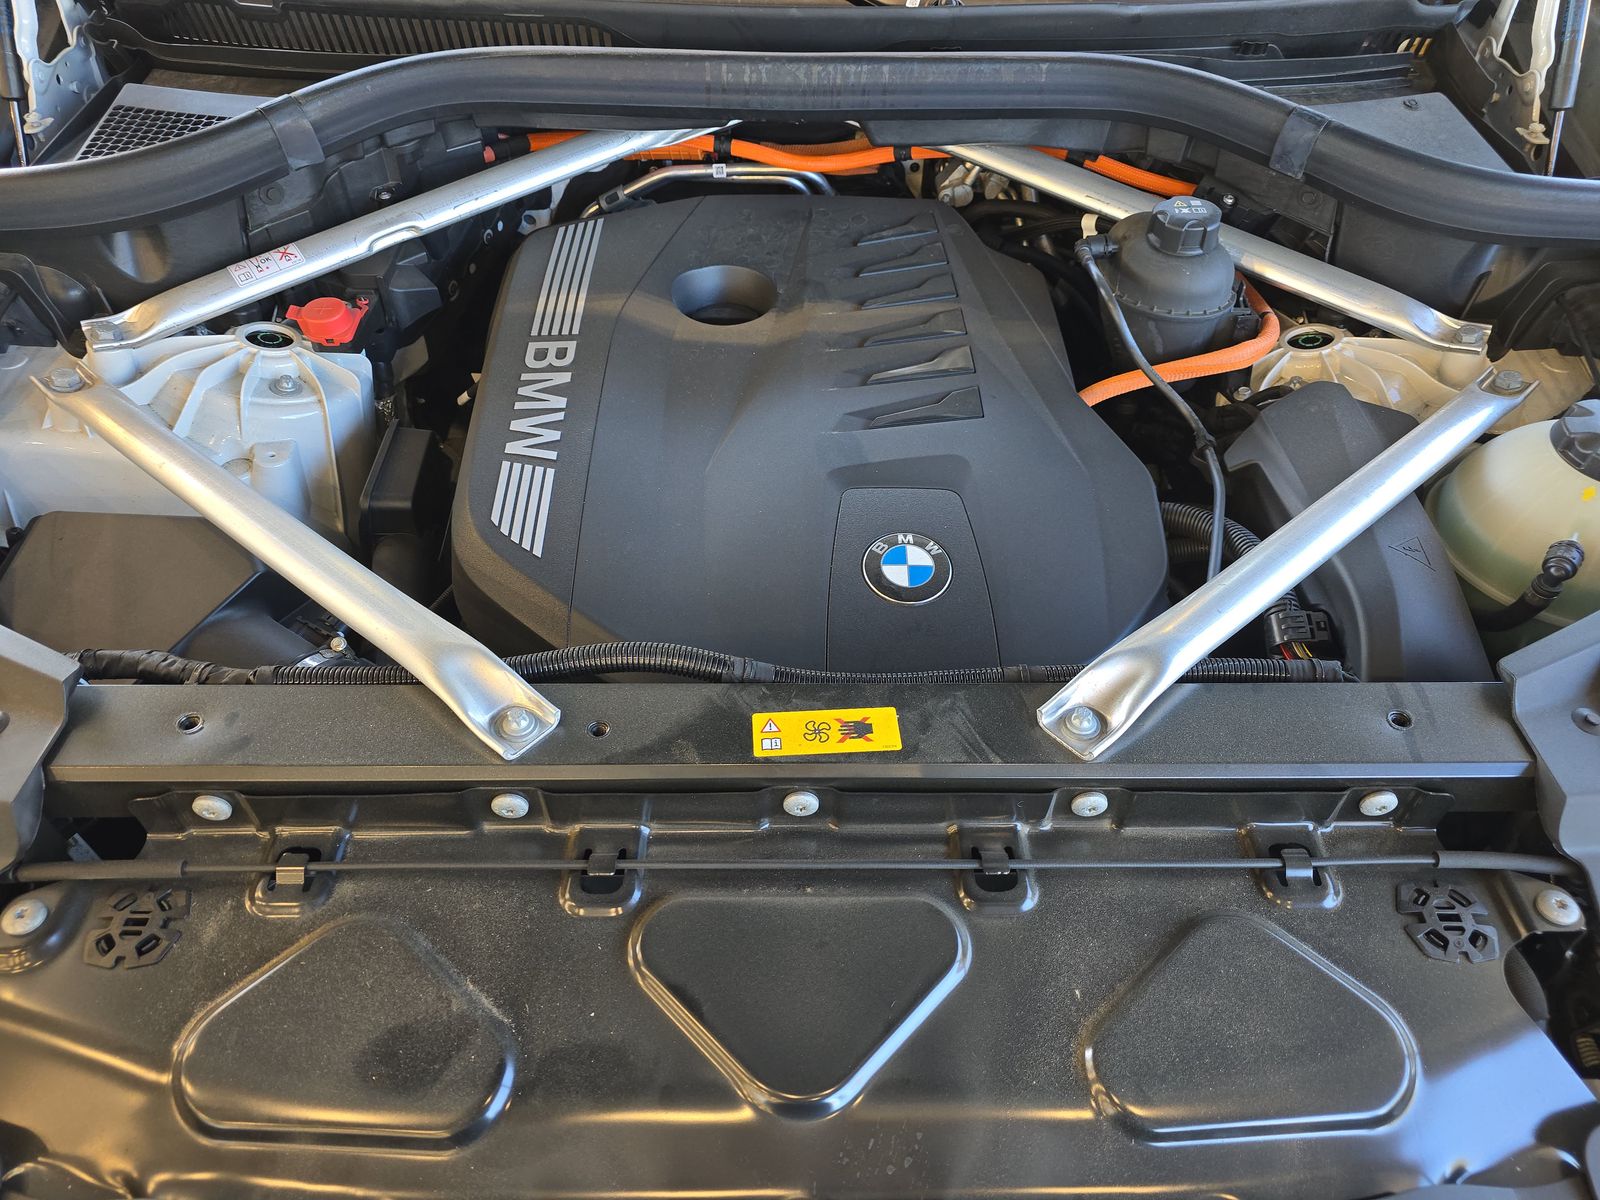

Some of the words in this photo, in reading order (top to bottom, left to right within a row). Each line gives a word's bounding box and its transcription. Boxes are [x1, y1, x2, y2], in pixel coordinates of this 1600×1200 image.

[260, 256, 272, 264] OK
[504, 340, 577, 460] BMW
[872, 533, 942, 555] BMW
